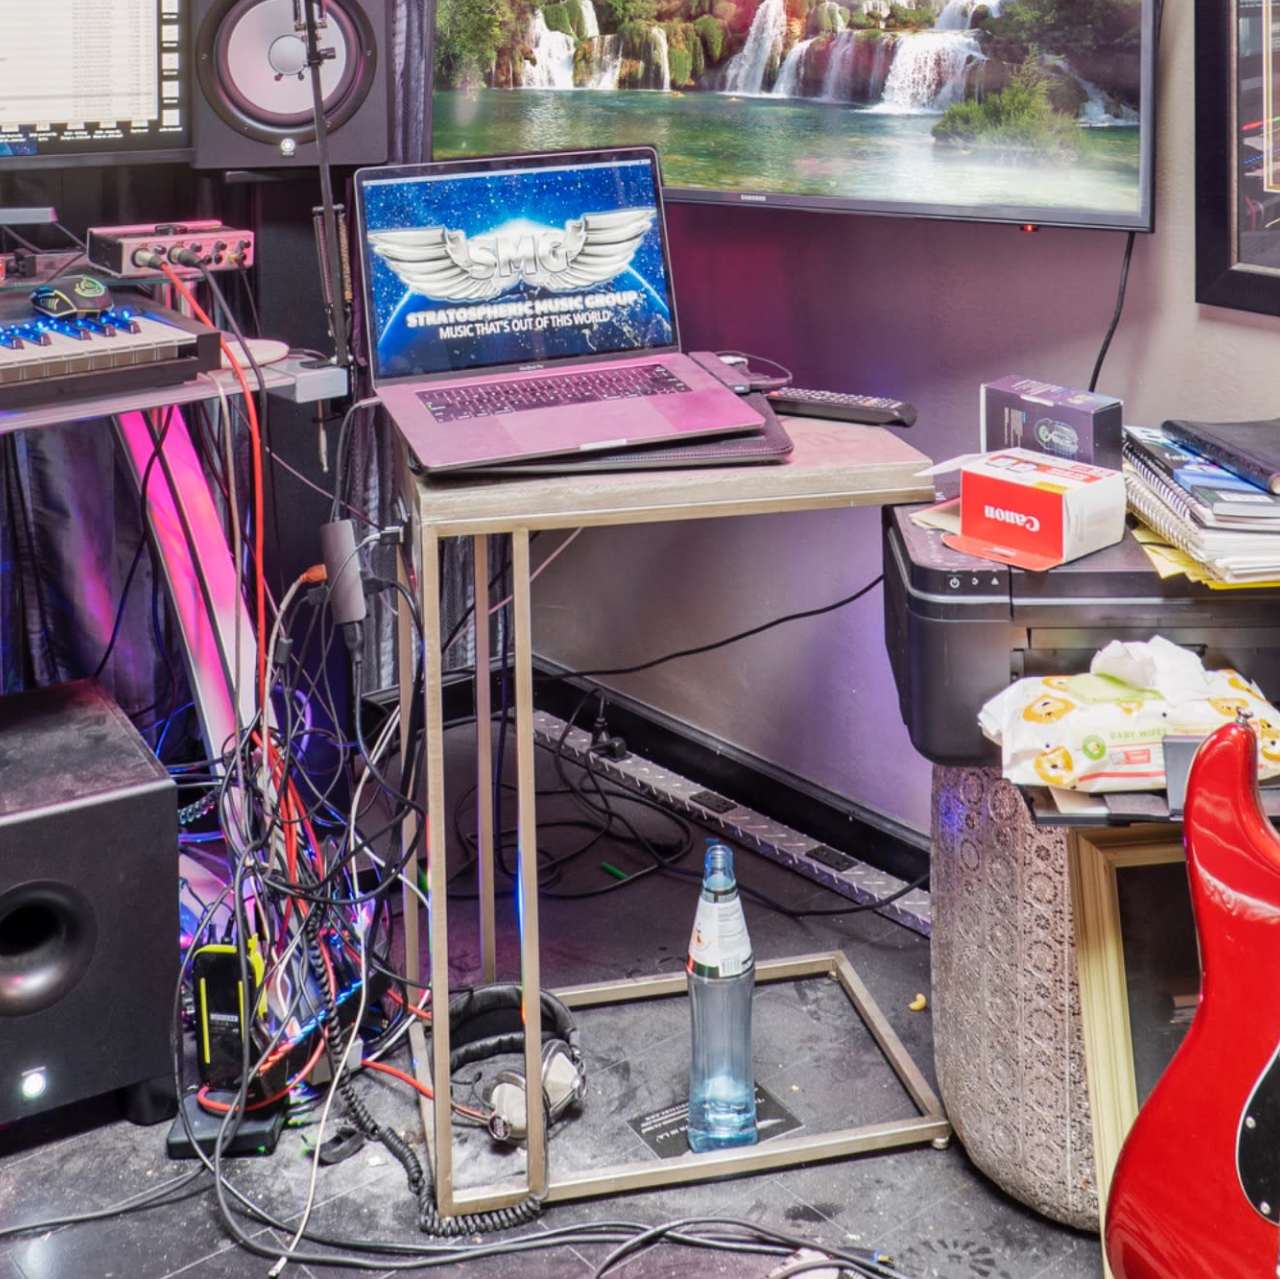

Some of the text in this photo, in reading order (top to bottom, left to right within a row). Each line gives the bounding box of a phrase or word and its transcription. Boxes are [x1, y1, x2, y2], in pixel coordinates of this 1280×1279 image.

[467, 236, 570, 280] SMG
[406, 290, 639, 328] STRATOSPHERIC MUSIC GROUP
[439, 310, 610, 339] MUSIC THAT'S OUT OF THIS WORLD
[984, 505, 1040, 532] Canon
